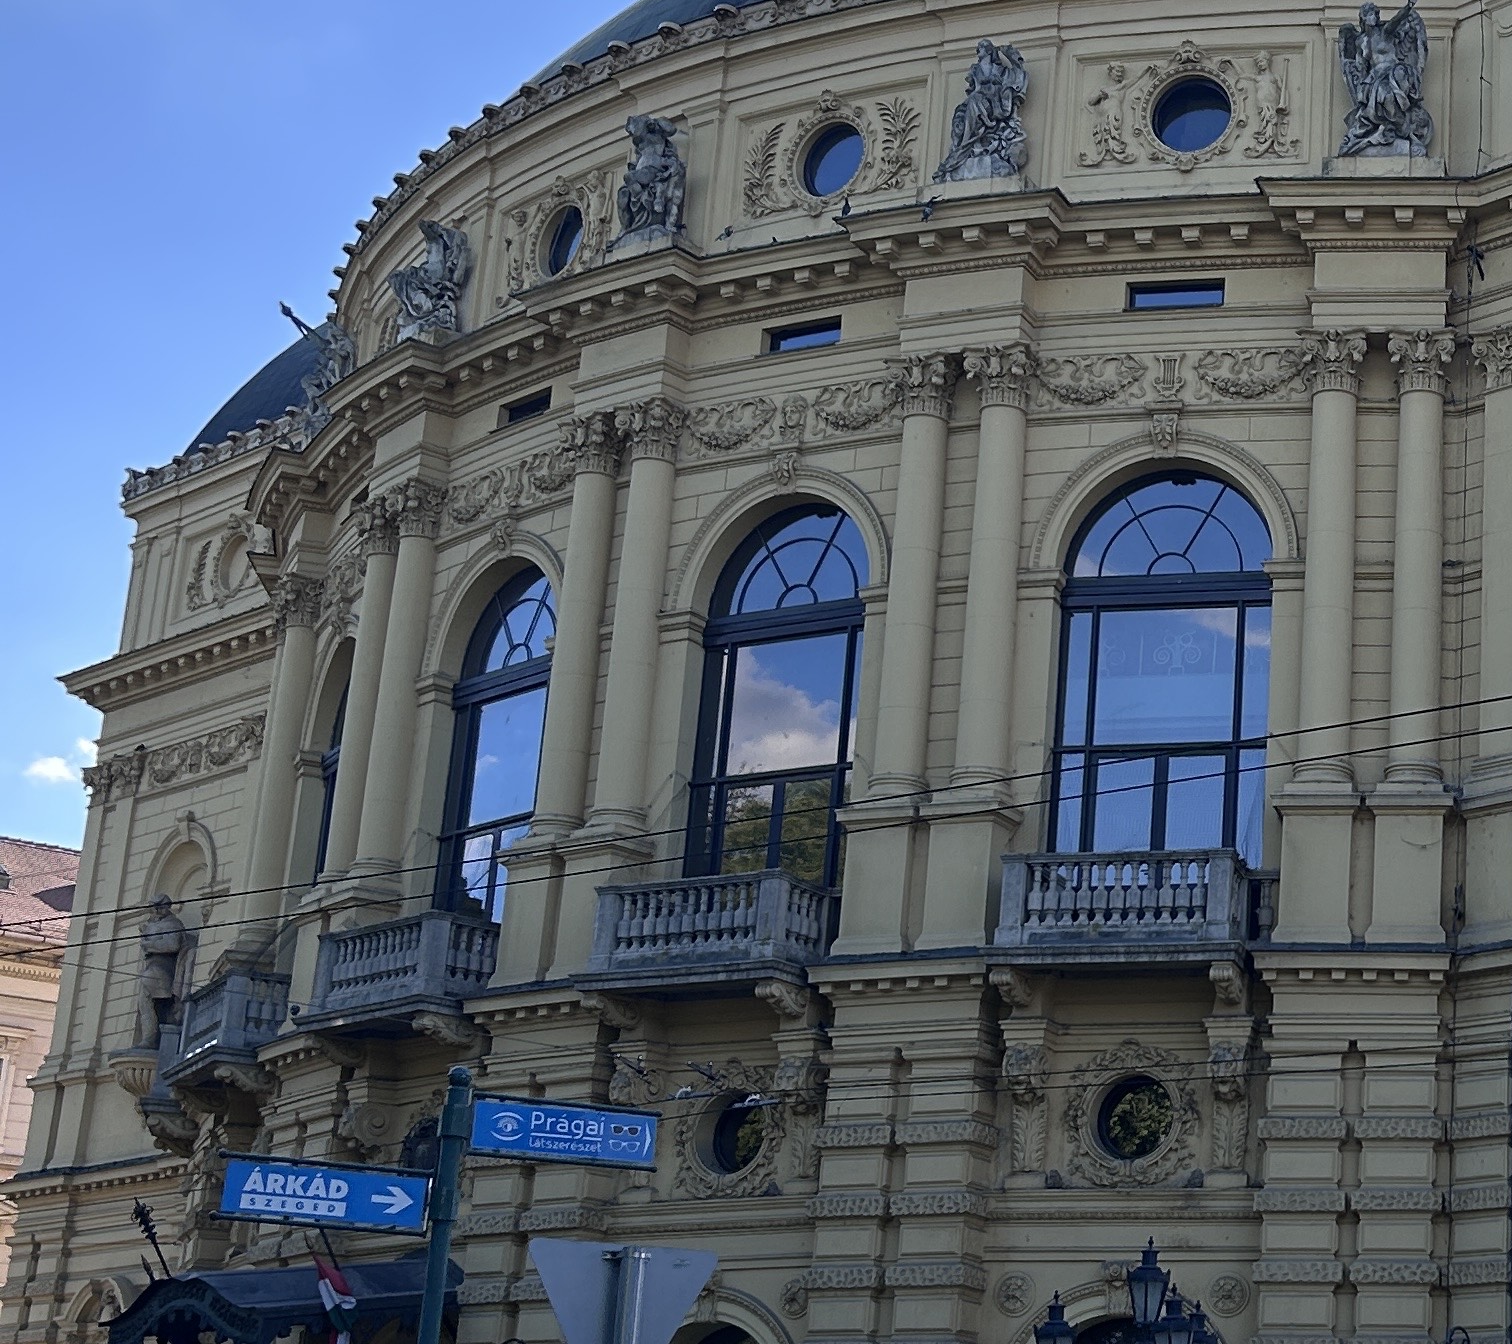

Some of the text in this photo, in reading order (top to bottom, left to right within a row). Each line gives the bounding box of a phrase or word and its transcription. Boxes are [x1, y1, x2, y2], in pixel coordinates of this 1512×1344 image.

[530, 1111, 606, 1140] Prágai
[242, 1166, 349, 1200] ÁRKÁD
[249, 1197, 336, 1214] SZEGED
